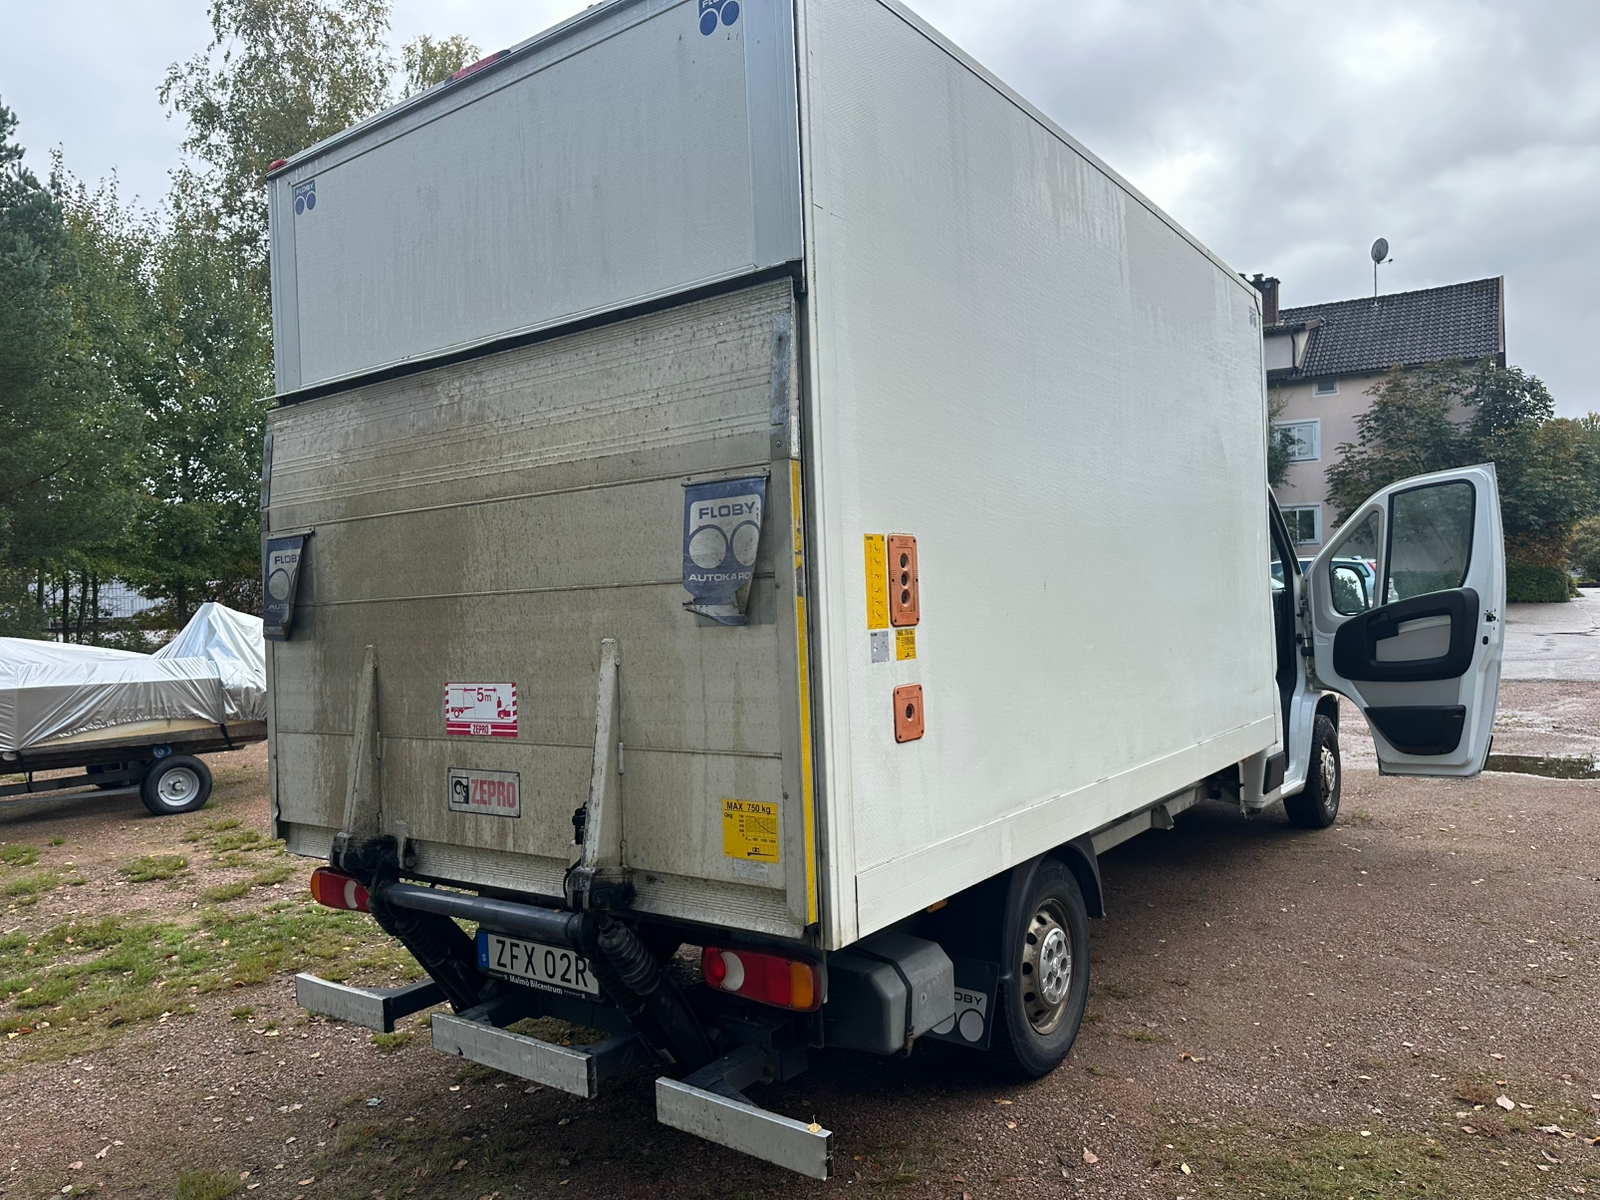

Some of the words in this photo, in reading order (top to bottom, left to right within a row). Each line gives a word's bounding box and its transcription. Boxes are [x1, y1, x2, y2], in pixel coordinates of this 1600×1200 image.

[699, 502, 755, 519] FLOBY
[473, 724, 489, 735] ZEPRO
[471, 779, 517, 809] ZEPRO
[726, 802, 743, 811] MAX
[747, 803, 760, 812] 750
[762, 805, 771, 815] kg
[495, 938, 537, 976] ZFX
[544, 949, 588, 988] 02R
[509, 974, 530, 987] Malmö
[530, 979, 563, 995] Bilcentrum
